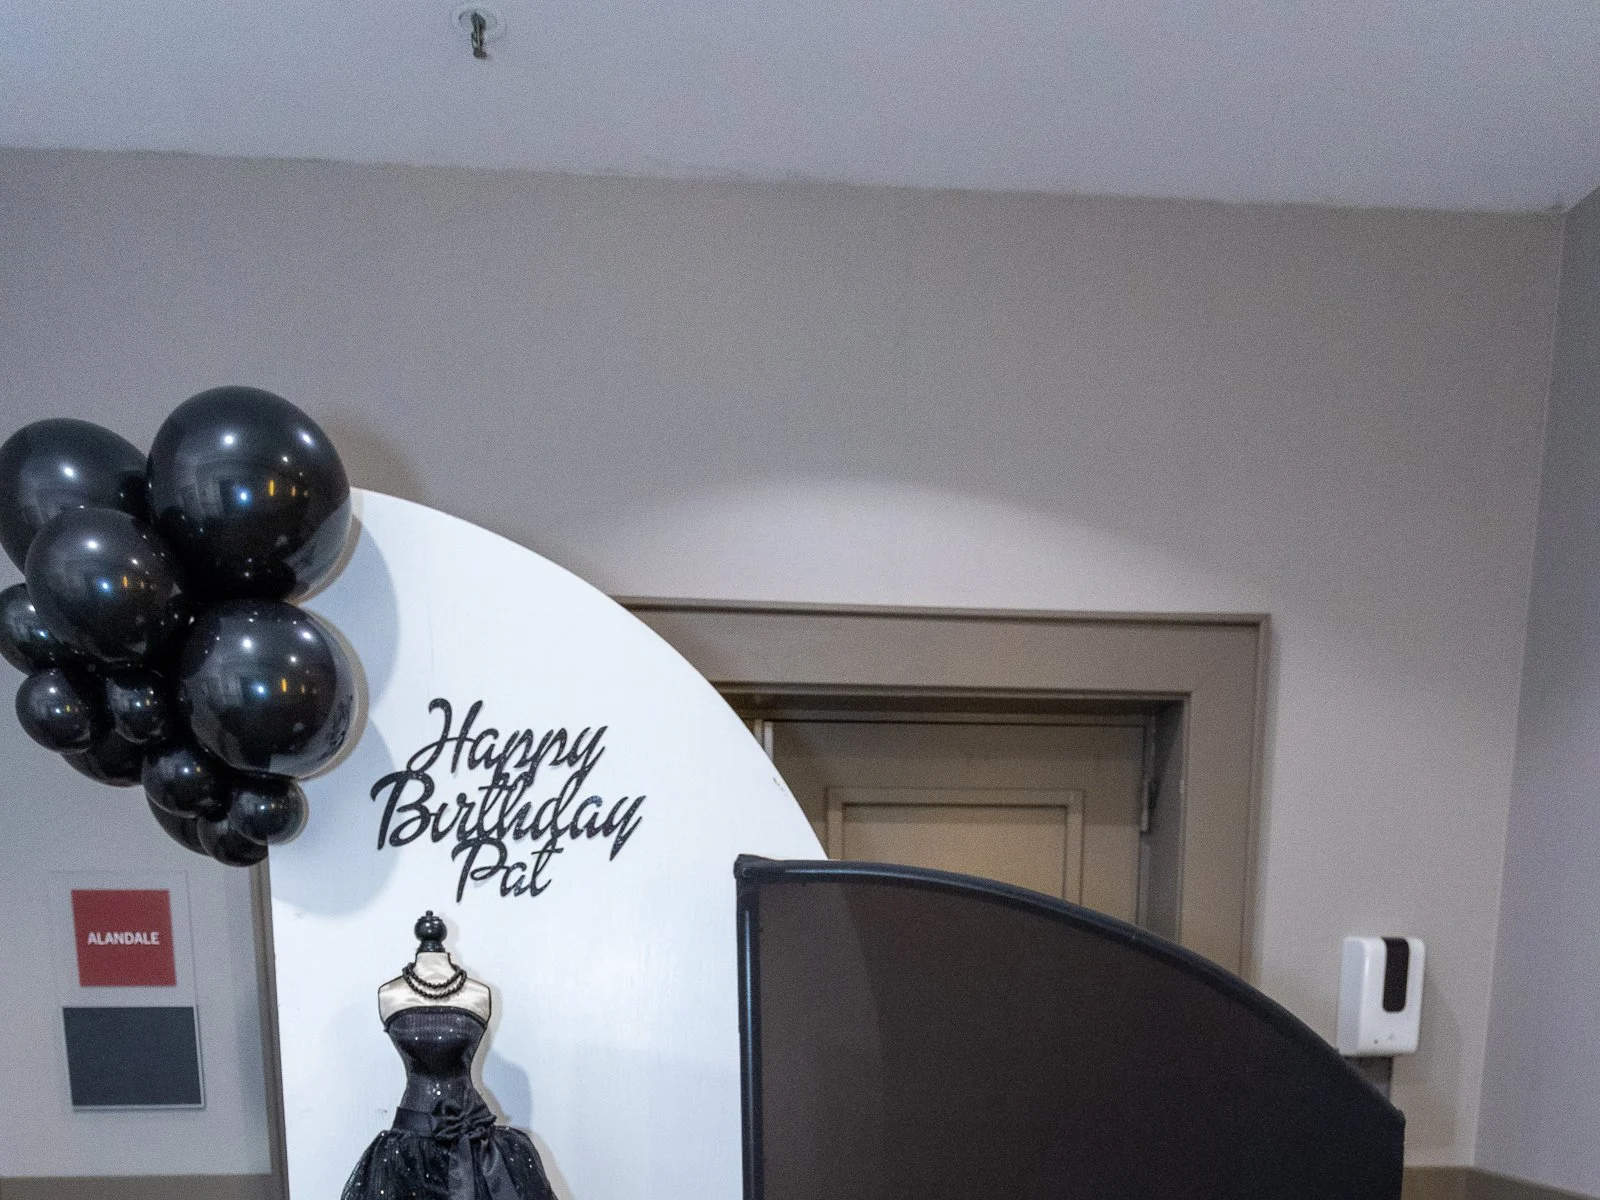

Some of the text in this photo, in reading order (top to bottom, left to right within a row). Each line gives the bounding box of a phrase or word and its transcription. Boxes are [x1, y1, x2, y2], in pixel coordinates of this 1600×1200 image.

[406, 697, 608, 788] Happy
[370, 769, 647, 861] Birthday
[451, 837, 564, 903] Pat
[87, 931, 160, 945] ALANDALE
